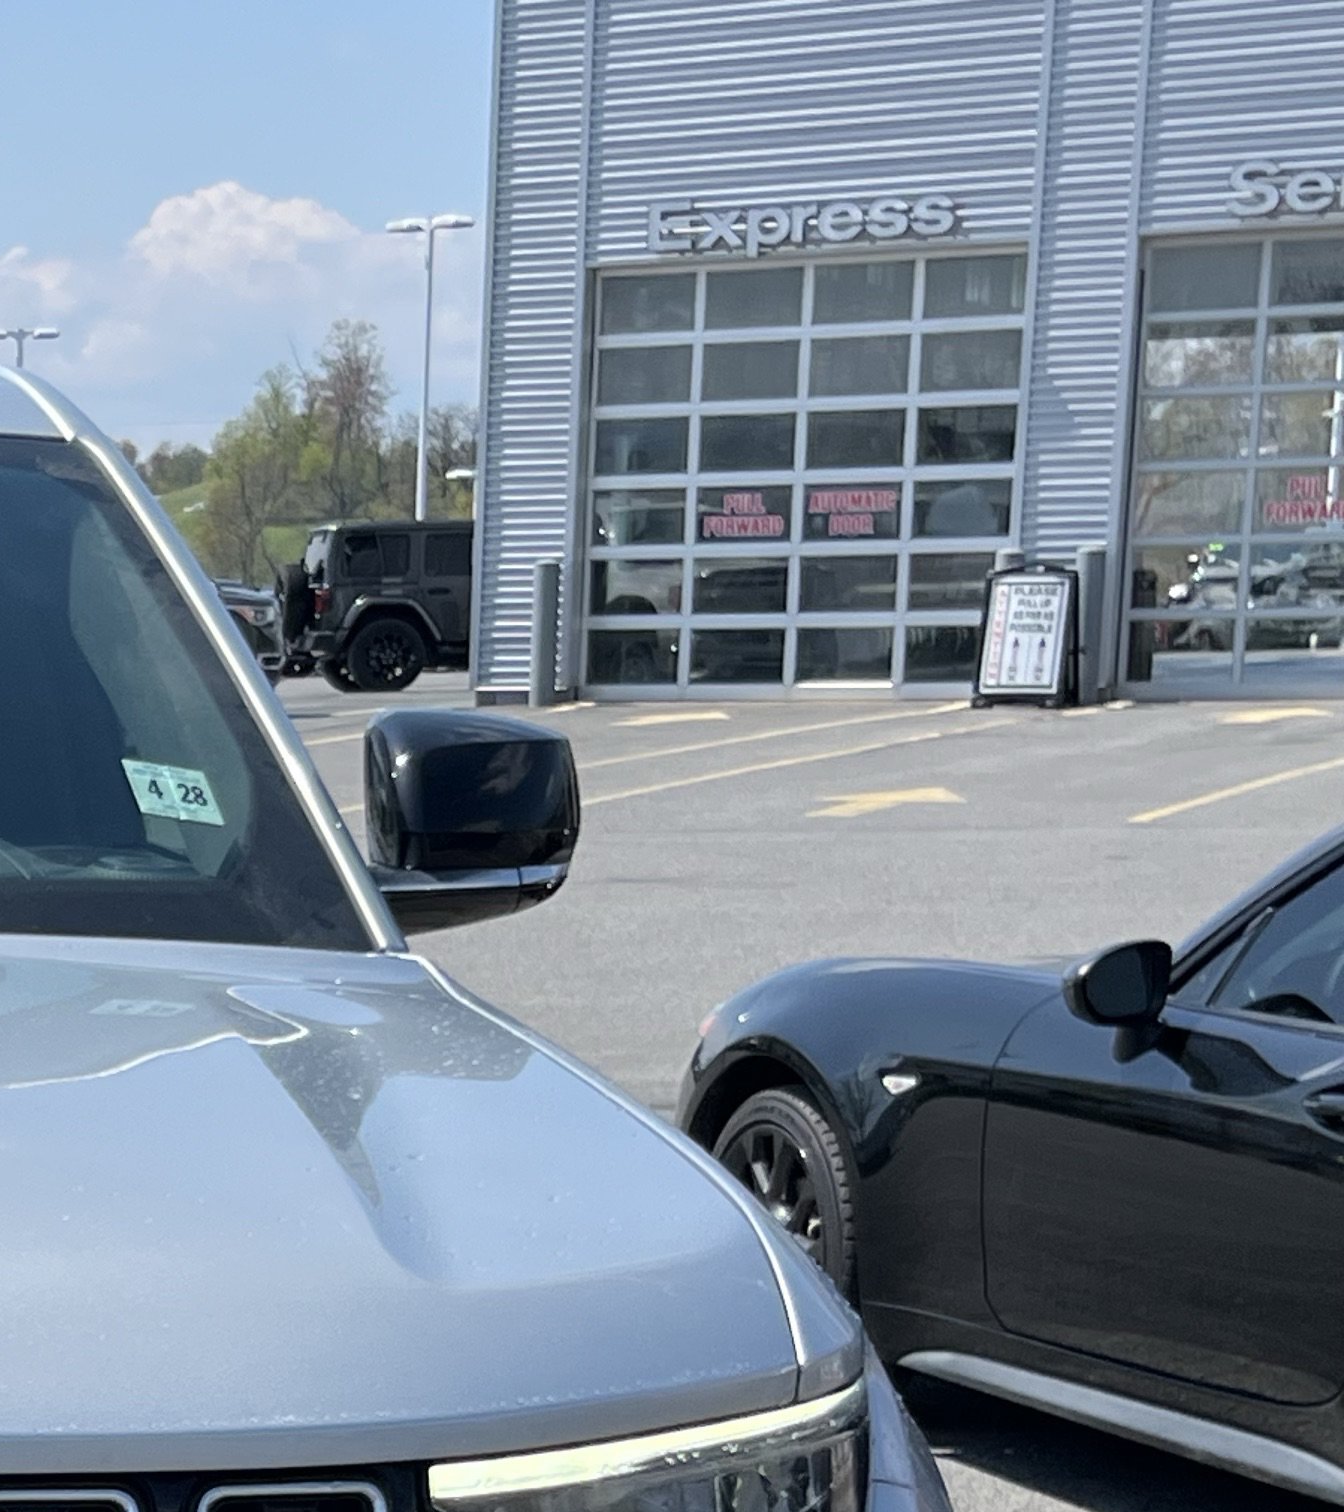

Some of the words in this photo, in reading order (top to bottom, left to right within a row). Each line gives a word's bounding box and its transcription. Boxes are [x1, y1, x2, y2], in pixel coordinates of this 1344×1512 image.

[1226, 160, 1344, 216] Se
[647, 194, 955, 258] Express
[723, 492, 767, 514] PULL
[808, 490, 897, 513] AUTOMATIC
[828, 513, 874, 535] DOOR
[1264, 500, 1344, 528] FORWAR
[703, 515, 785, 537] FORWARD
[176, 783, 208, 807] 28
